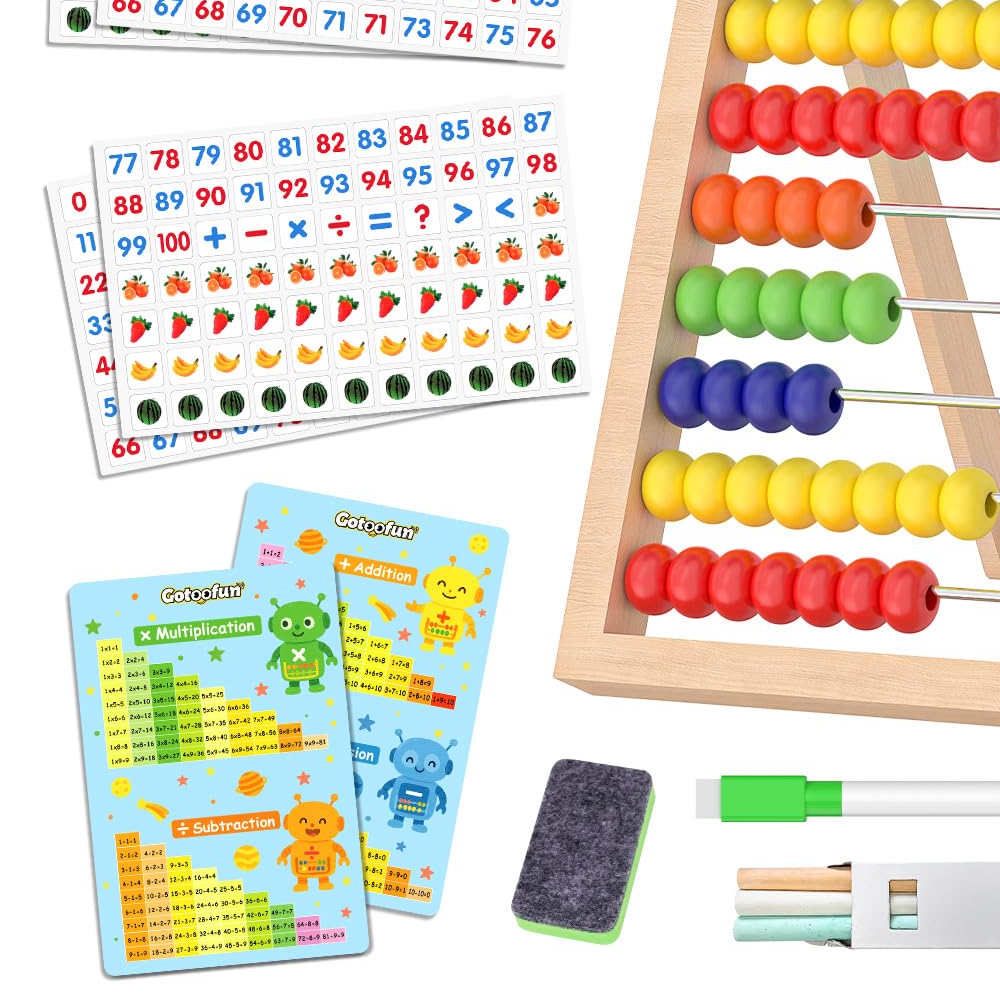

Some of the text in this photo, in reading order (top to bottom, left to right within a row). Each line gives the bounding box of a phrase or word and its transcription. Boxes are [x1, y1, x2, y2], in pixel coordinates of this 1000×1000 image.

[195, 0, 224, 20] 68
[237, 3, 266, 24] 69
[279, 6, 307, 27] 70
[324, 10, 345, 31] 71
[365, 14, 386, 34] 71
[403, 17, 430, 38] 73
[445, 20, 473, 42] 74
[486, 24, 514, 45] 75
[528, 28, 555, 49] 76
[109, 111, 551, 174] 77 78 79 80 81 82 83 84 85 86 87
[114, 153, 557, 215] 88 89 90 91 92 93 94 95 96 97 98
[72, 192, 86, 212] 0
[118, 236, 146, 257] 99
[157, 231, 190, 253] 100
[204, 227, 226, 248] +
[369, 213, 392, 230] =
[414, 204, 430, 229] ?
[454, 204, 472, 223] >
[496, 198, 514, 218] <
[76, 232, 96, 253] 11
[80, 272, 108, 295] 22
[88, 313, 112, 335] 33
[112, 437, 140, 458] 66
[355, 562, 413, 582] Addition
[156, 619, 255, 640] Multiplication
[193, 815, 276, 834] Subtraction
